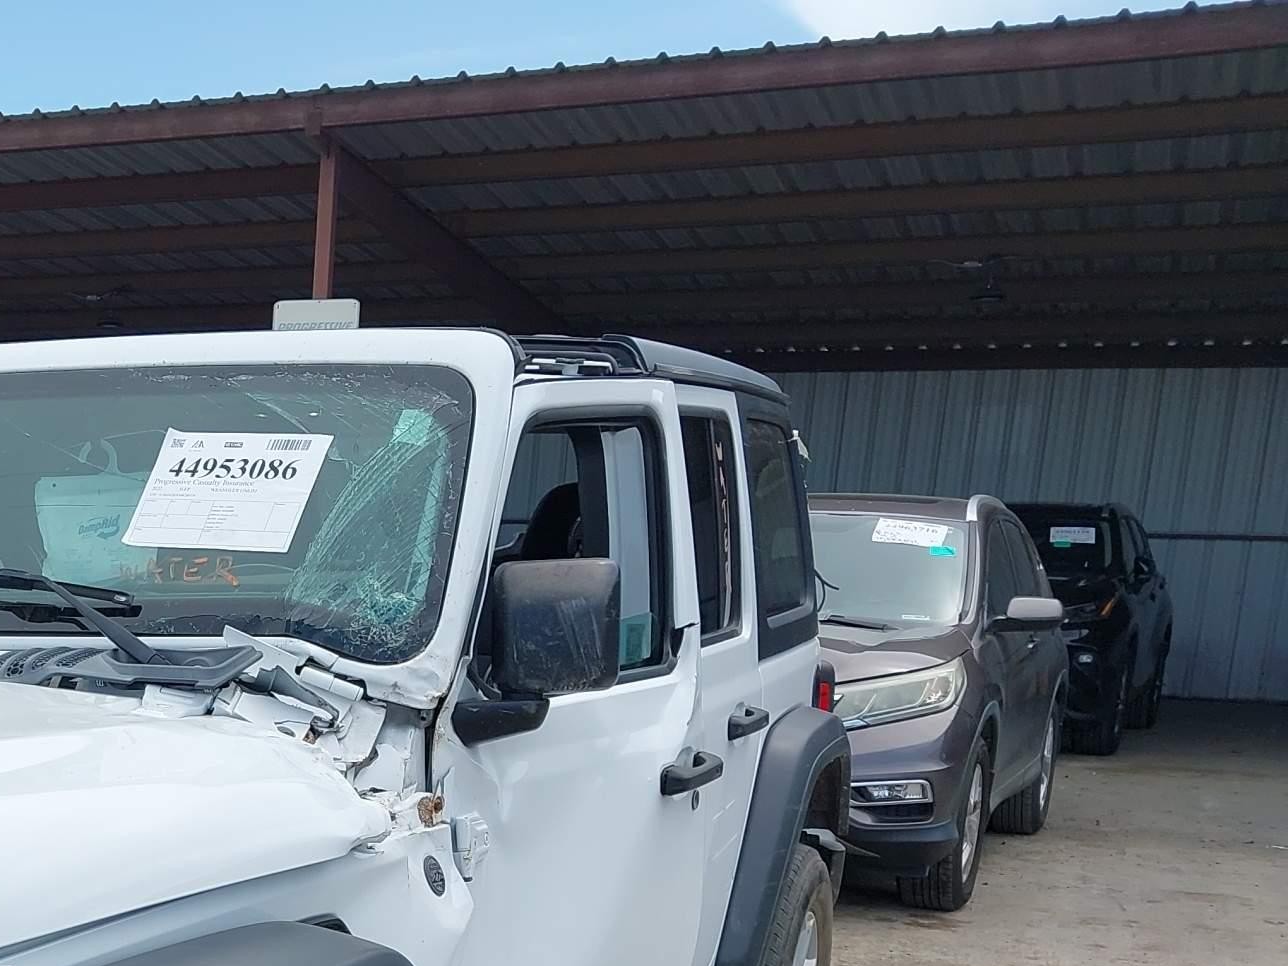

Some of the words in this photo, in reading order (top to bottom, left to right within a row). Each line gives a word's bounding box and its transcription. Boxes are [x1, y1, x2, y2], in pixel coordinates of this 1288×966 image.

[168, 457, 299, 480] 44953086
[153, 478, 192, 487] Progressive
[192, 479, 220, 487] Casualty
[221, 480, 256, 488] Insurance
